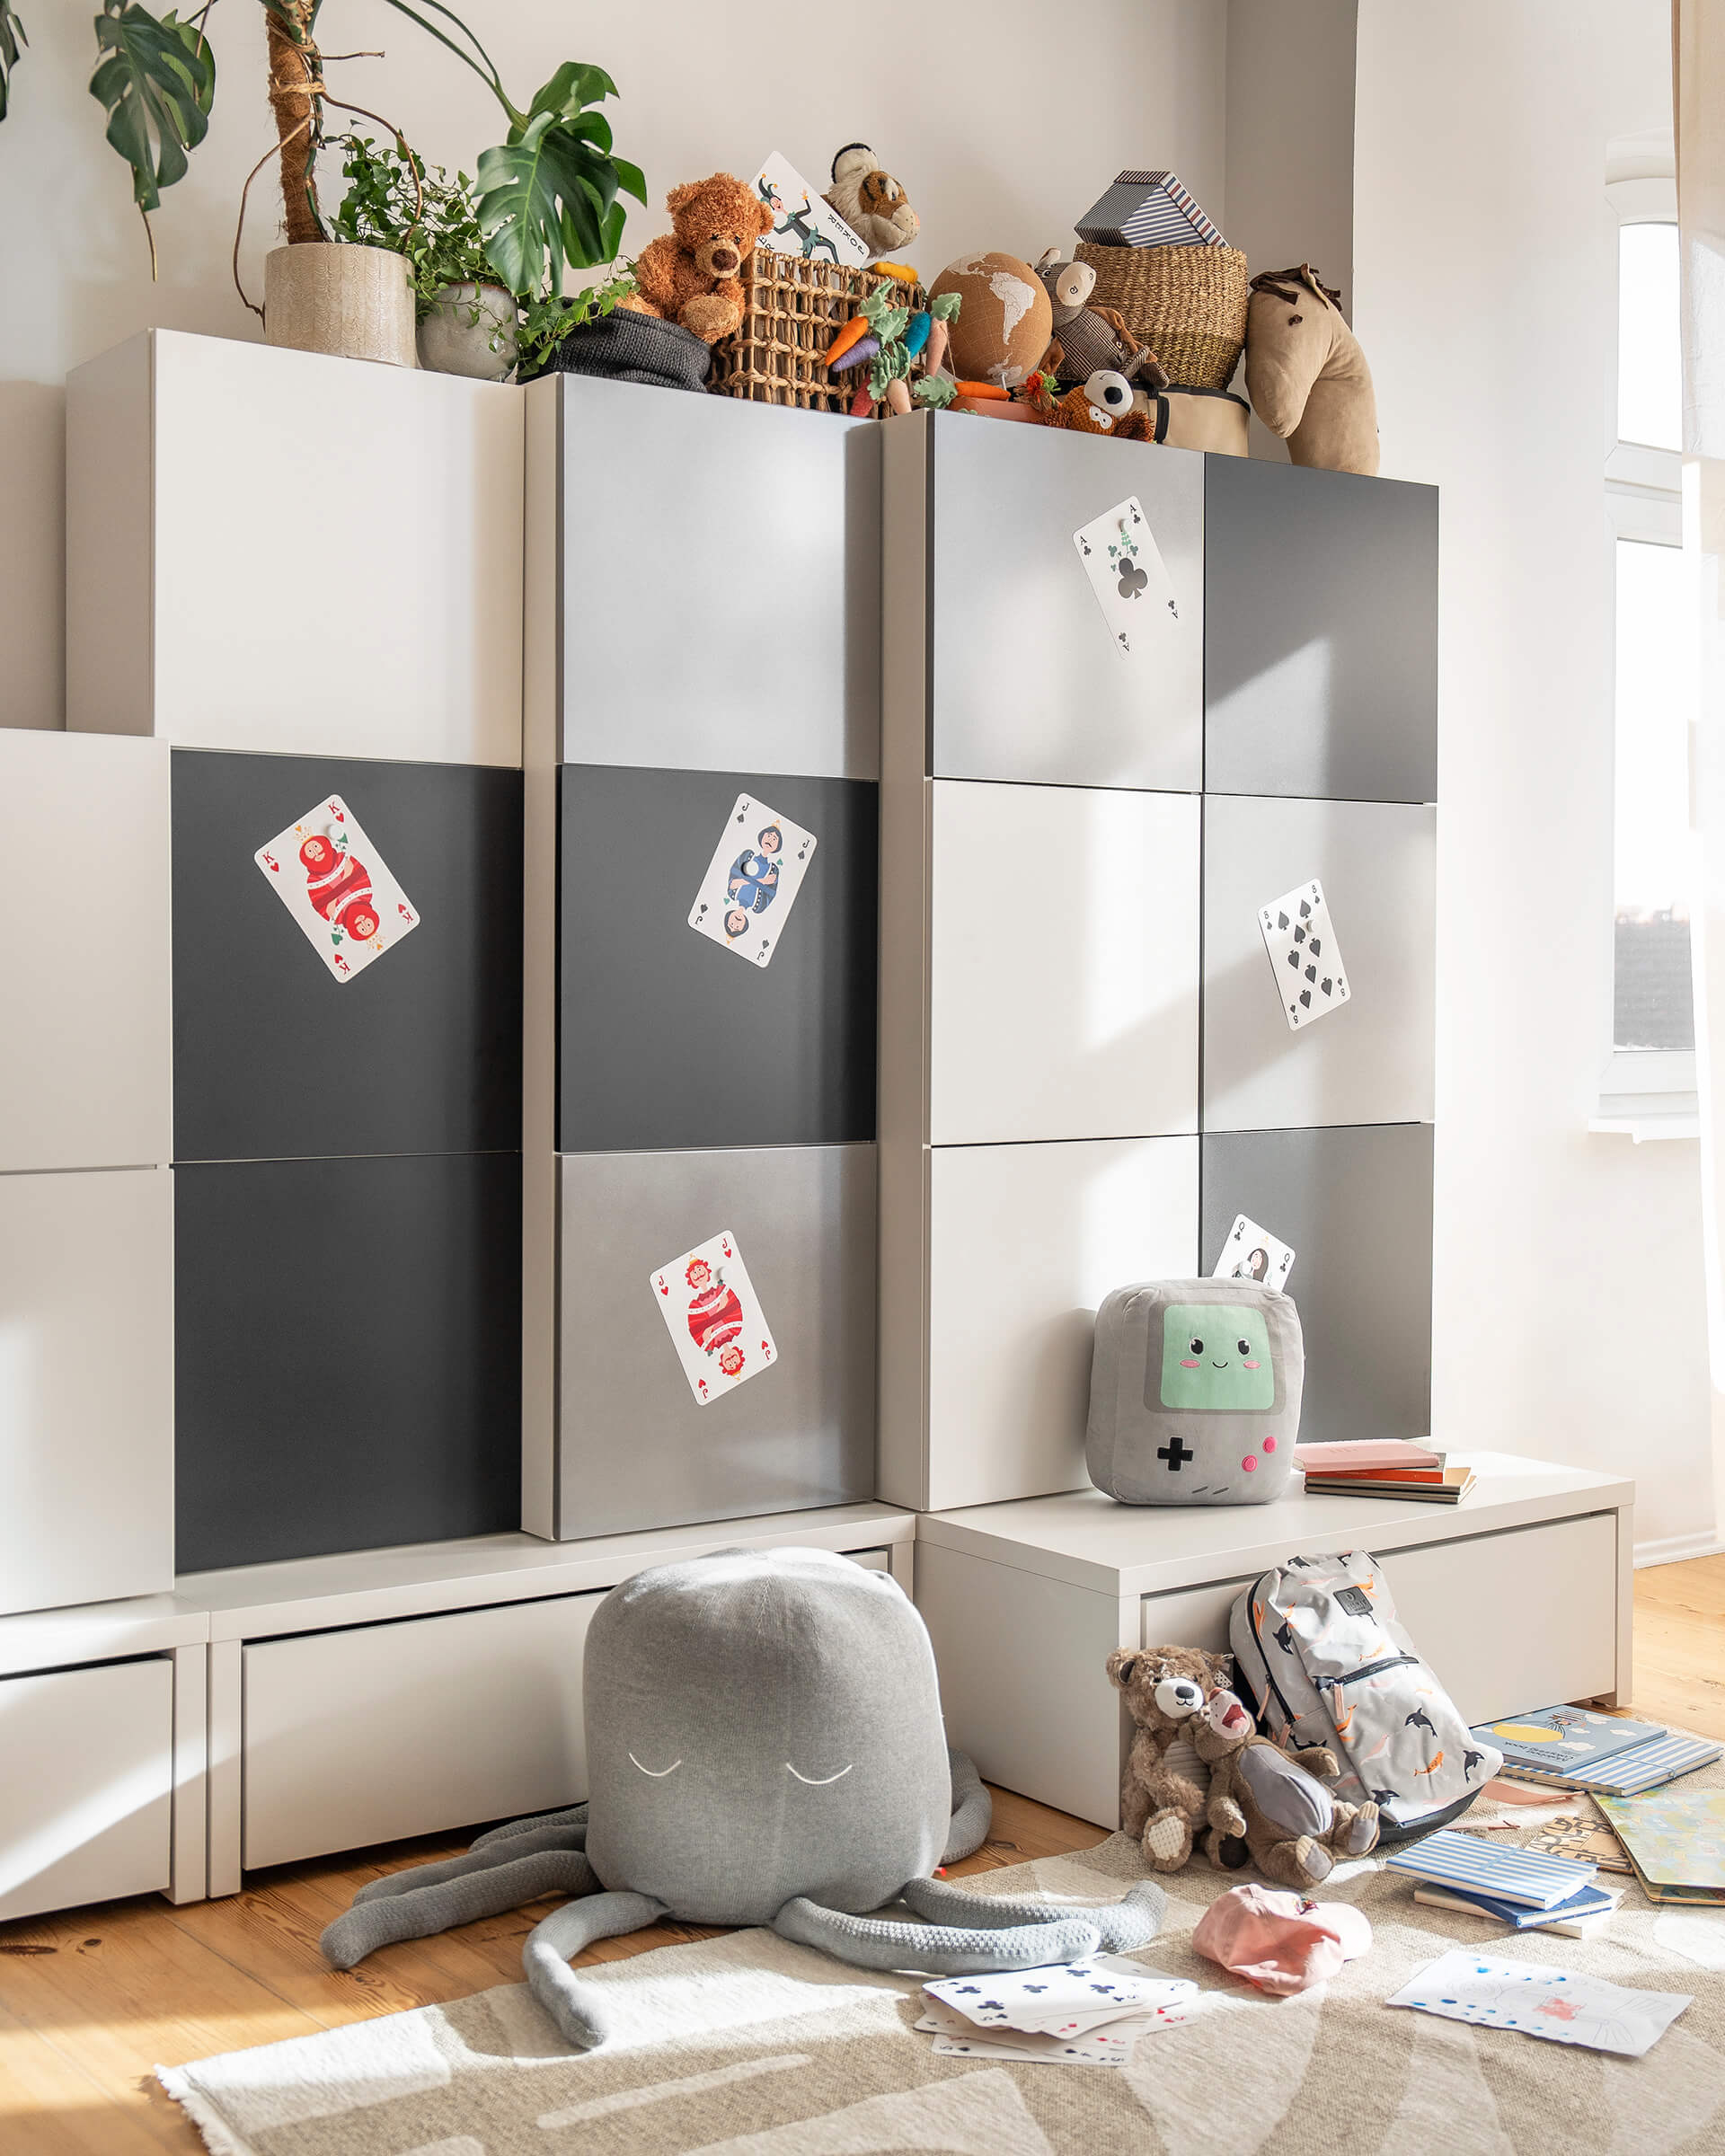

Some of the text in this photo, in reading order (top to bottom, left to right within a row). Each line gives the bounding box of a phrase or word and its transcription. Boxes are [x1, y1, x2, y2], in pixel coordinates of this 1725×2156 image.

[827, 214, 864, 255] JOKER
[1129, 504, 1137, 514] A
[1080, 535, 1087, 545] A
[328, 801, 341, 814] K
[741, 803, 750, 811] J
[801, 840, 810, 848] J
[262, 851, 275, 863] K
[402, 912, 414, 924] K
[694, 915, 703, 924] J
[756, 951, 765, 960] J
[339, 962, 351, 975] K
[1239, 1222, 1245, 1232] Q
[721, 1238, 728, 1249] J
[1284, 1253, 1290, 1263] Q
[658, 1275, 665, 1286] J
[765, 1349, 771, 1360] J
[702, 1388, 709, 1399] J
